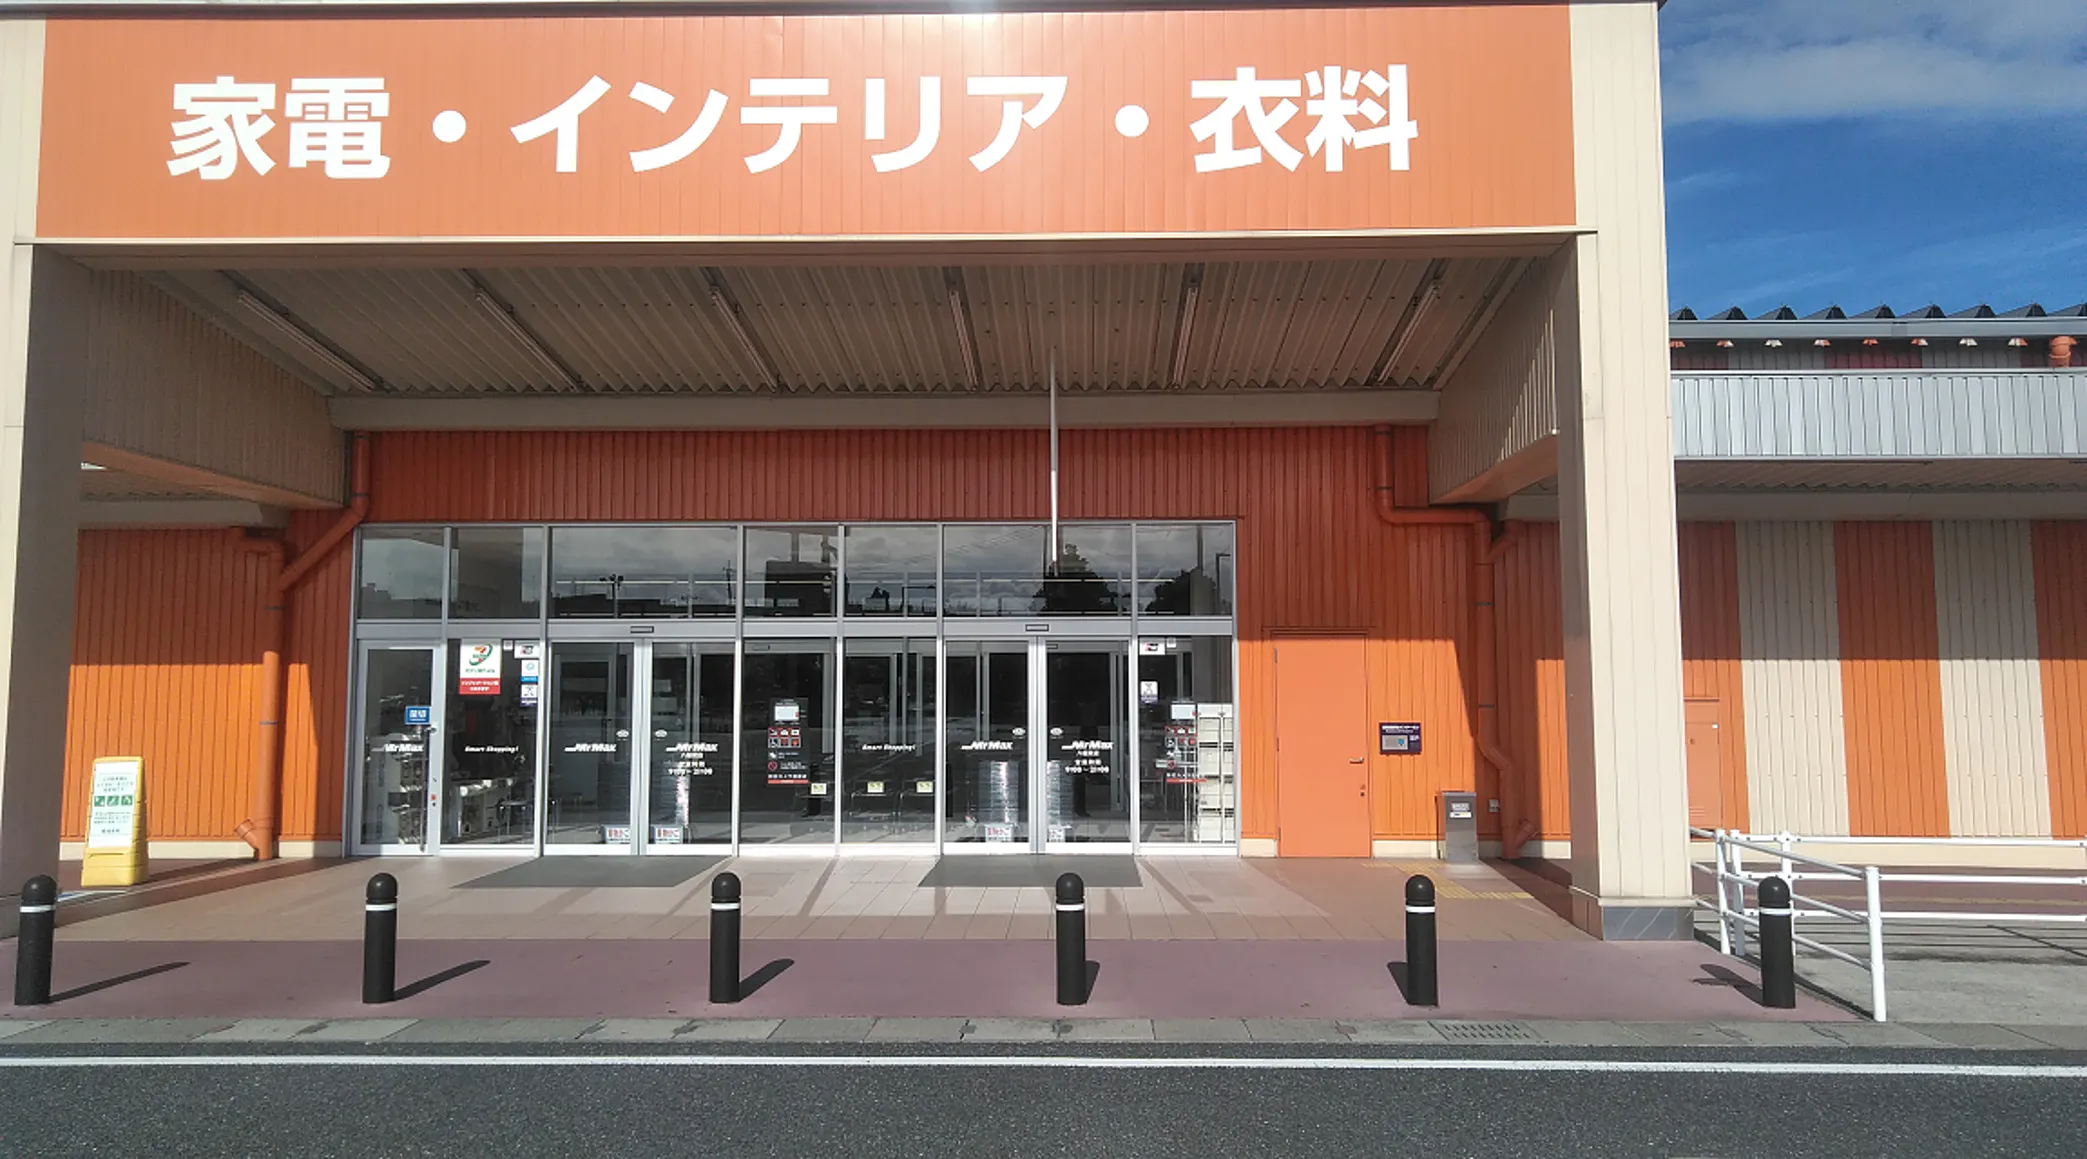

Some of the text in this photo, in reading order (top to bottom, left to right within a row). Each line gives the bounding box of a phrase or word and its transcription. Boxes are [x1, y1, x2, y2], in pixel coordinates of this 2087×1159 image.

[167, 64, 1419, 181] 家電・インテリア・衣料
